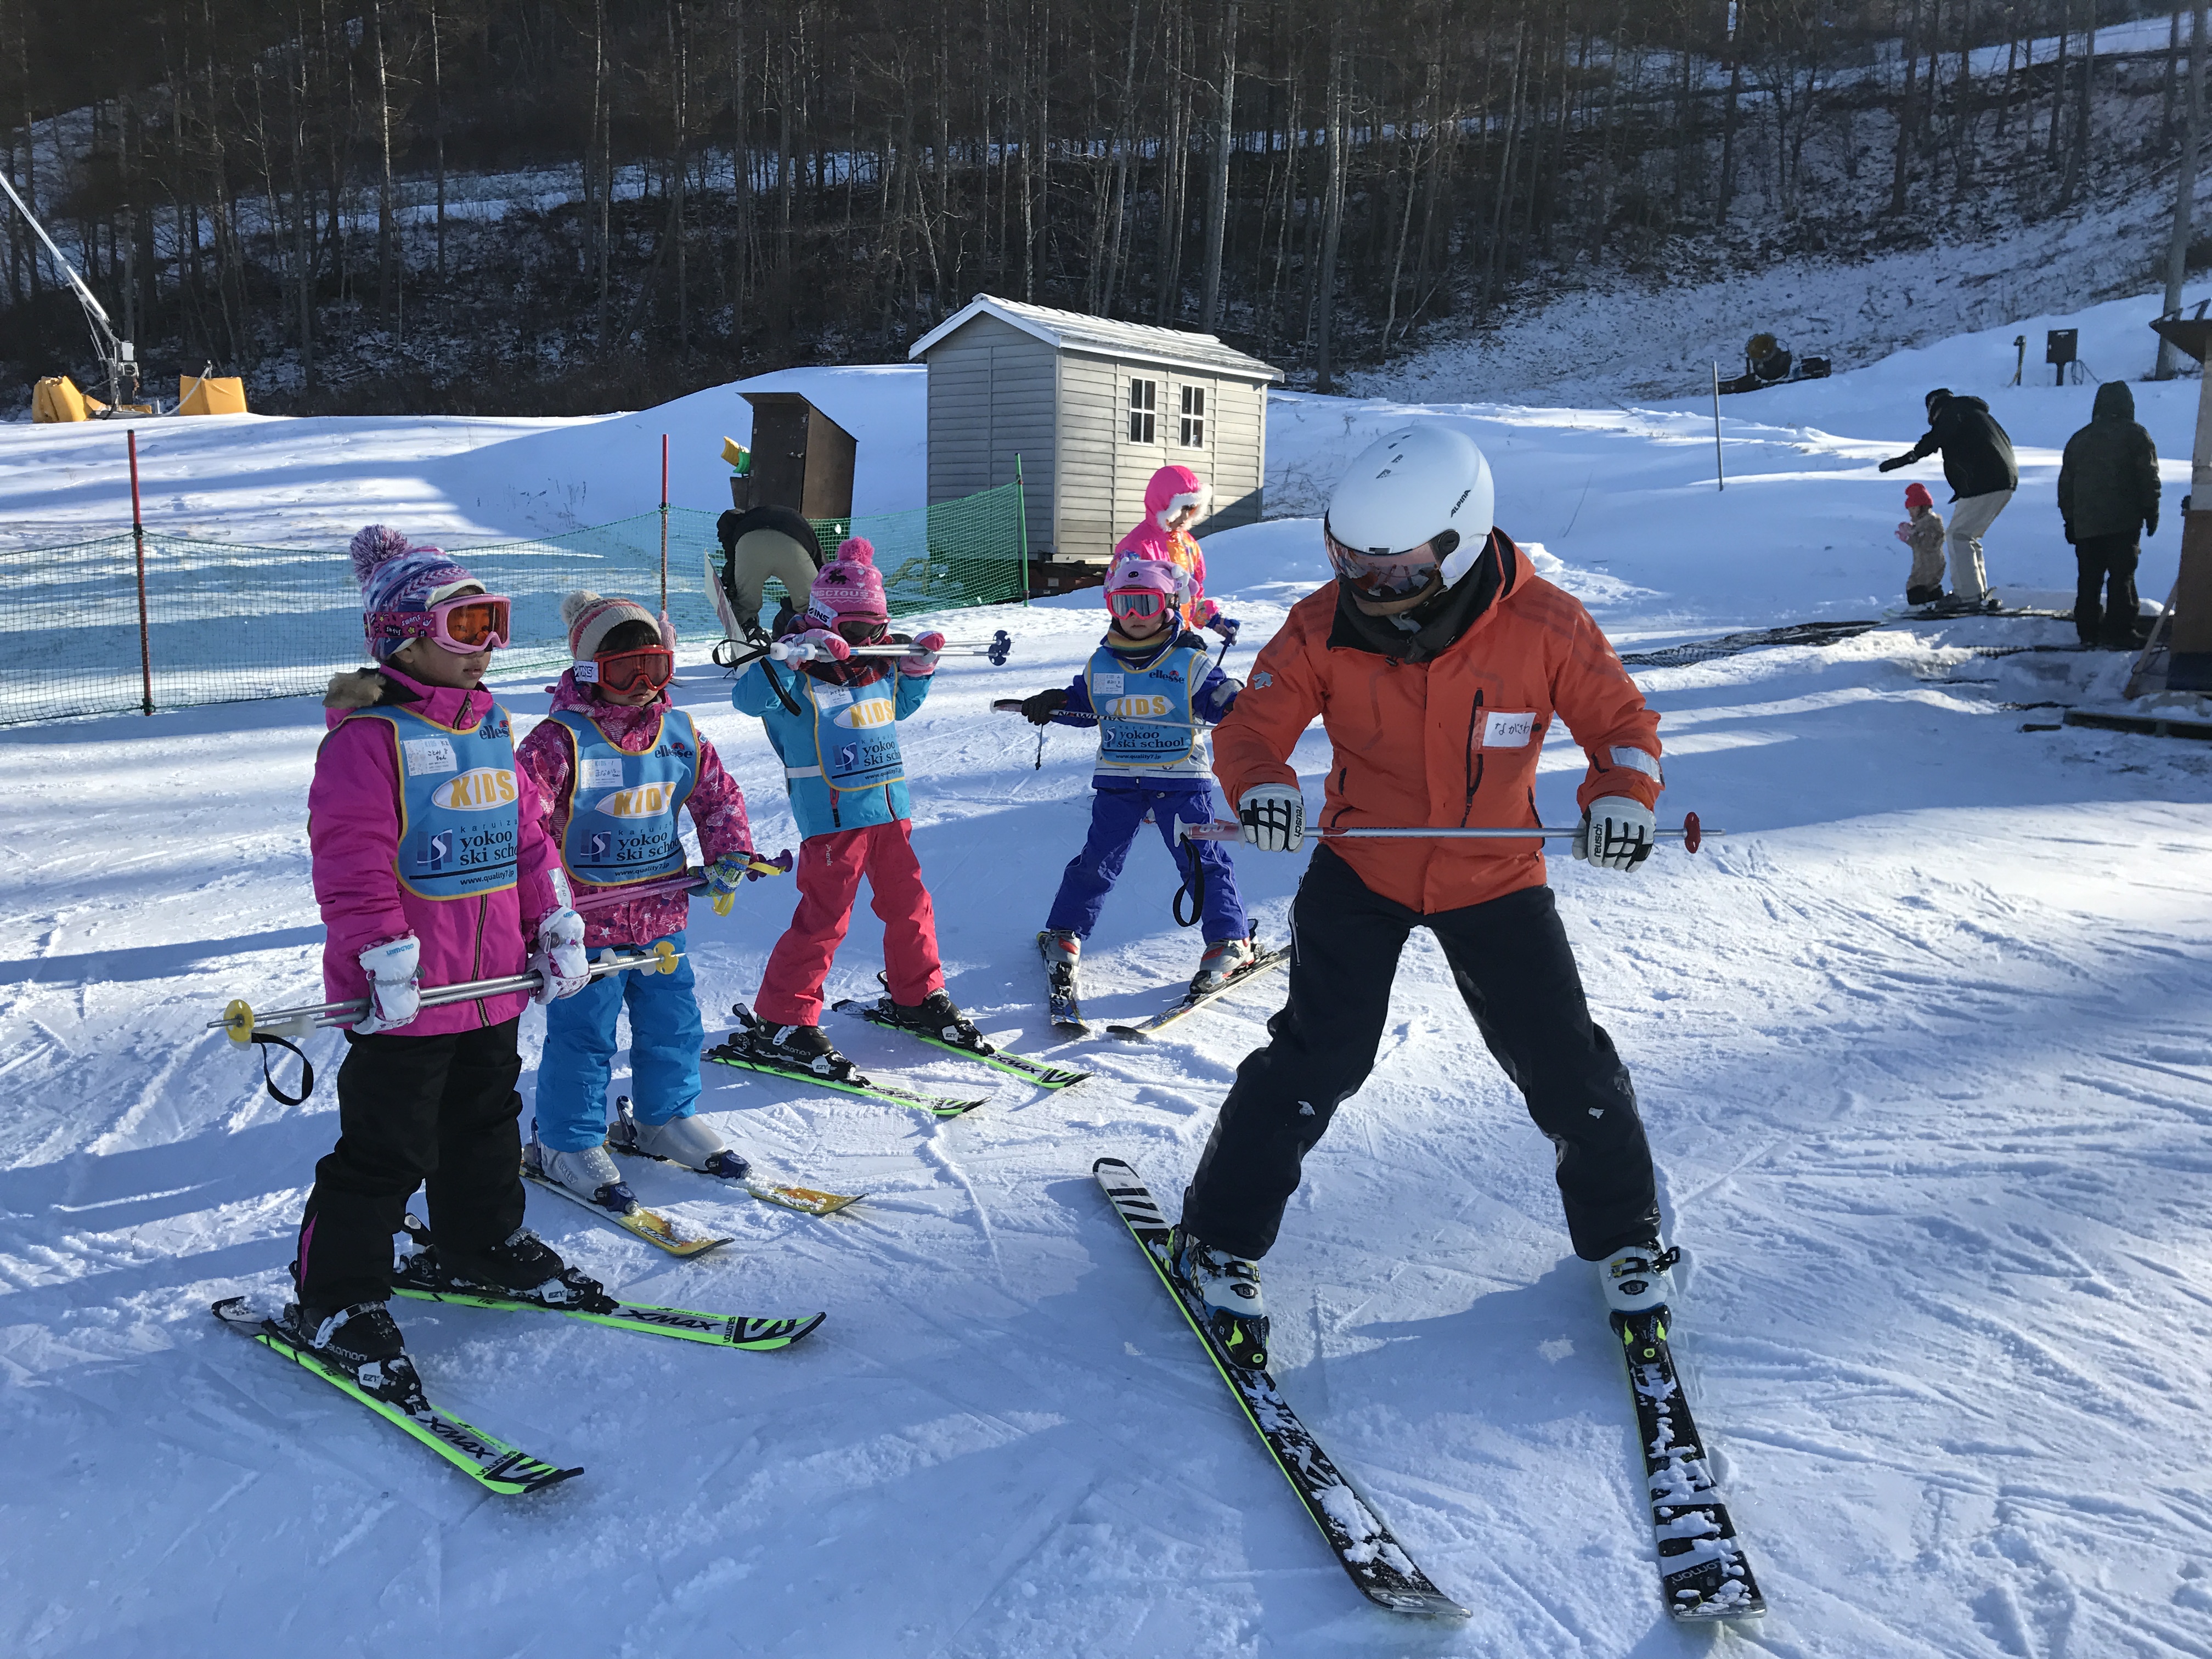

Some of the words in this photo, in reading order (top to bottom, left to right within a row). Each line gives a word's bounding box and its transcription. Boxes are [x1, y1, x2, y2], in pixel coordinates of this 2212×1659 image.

[1451, 489, 1471, 518] ALPINA
[1149, 669, 1185, 684] ellesse
[850, 700, 894, 728] KIDS
[1114, 696, 1167, 716] KIDS
[1119, 730, 1160, 740] yokoo
[1494, 721, 1531, 736] ながさわ
[862, 741, 895, 757] yokoo
[1116, 739, 1136, 748] ski
[1140, 737, 1184, 748] school
[654, 745, 694, 759] ellesse
[864, 753, 884, 766] ski
[865, 767, 902, 780] www.quality7.jp
[450, 771, 515, 808] KIDS
[1294, 805, 1302, 838] reusch
[460, 831, 512, 852] yokoo
[618, 832, 668, 851] yokoo
[1593, 823, 1602, 857] reusch
[460, 847, 489, 866] ski
[616, 847, 644, 861] ski
[460, 869, 515, 885] www.quality7.jp
[614, 862, 670, 876] www.quality7.jp
[548, 1290, 566, 1299] EZY
[614, 1309, 722, 1330] XMAX
[363, 1373, 380, 1383] EZY
[415, 1415, 496, 1460] XMAX
